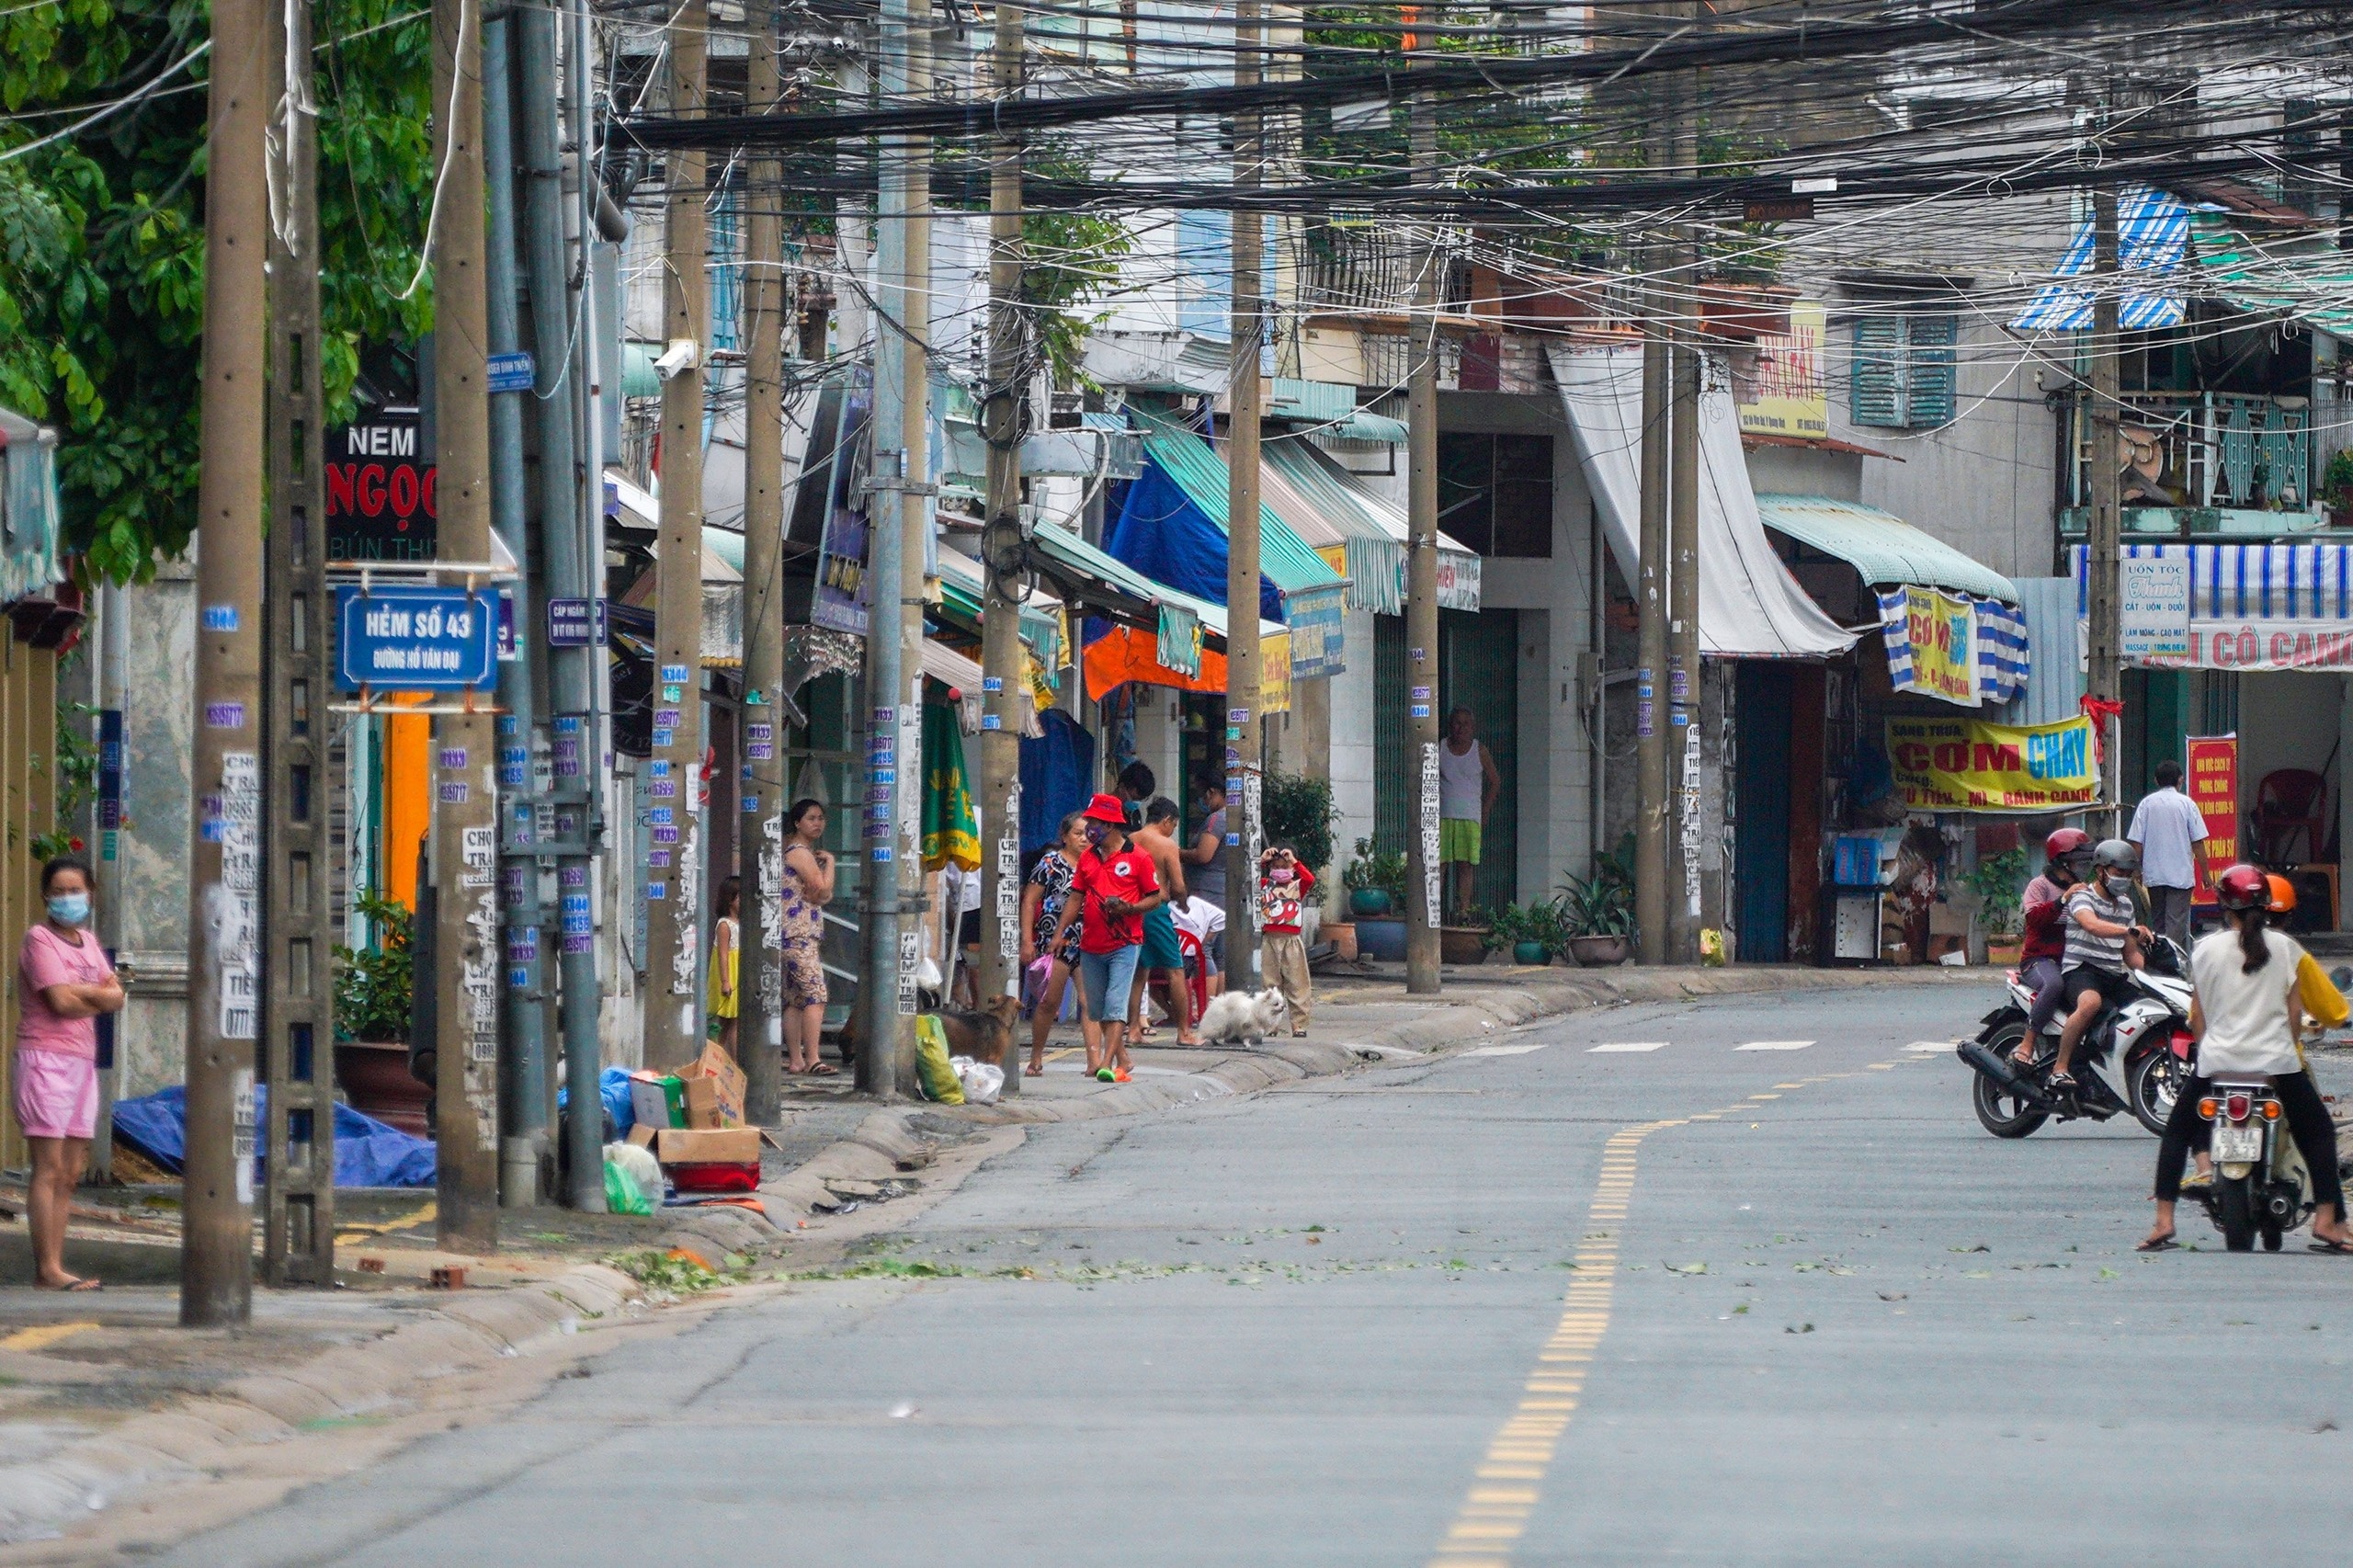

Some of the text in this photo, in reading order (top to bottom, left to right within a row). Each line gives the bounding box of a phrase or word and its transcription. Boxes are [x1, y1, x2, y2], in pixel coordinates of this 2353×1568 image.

[347, 426, 415, 456] NEM
[2128, 562, 2185, 574] UỐN TÓC
[2128, 576, 2185, 598] Thanh
[366, 603, 472, 639] HẺM SỐ 43
[2212, 625, 2260, 667] CÔ
[1895, 728, 2087, 780] CƠM CHAY
[2003, 789, 2045, 807] BÁNH
[2050, 788, 2092, 803] CANH
